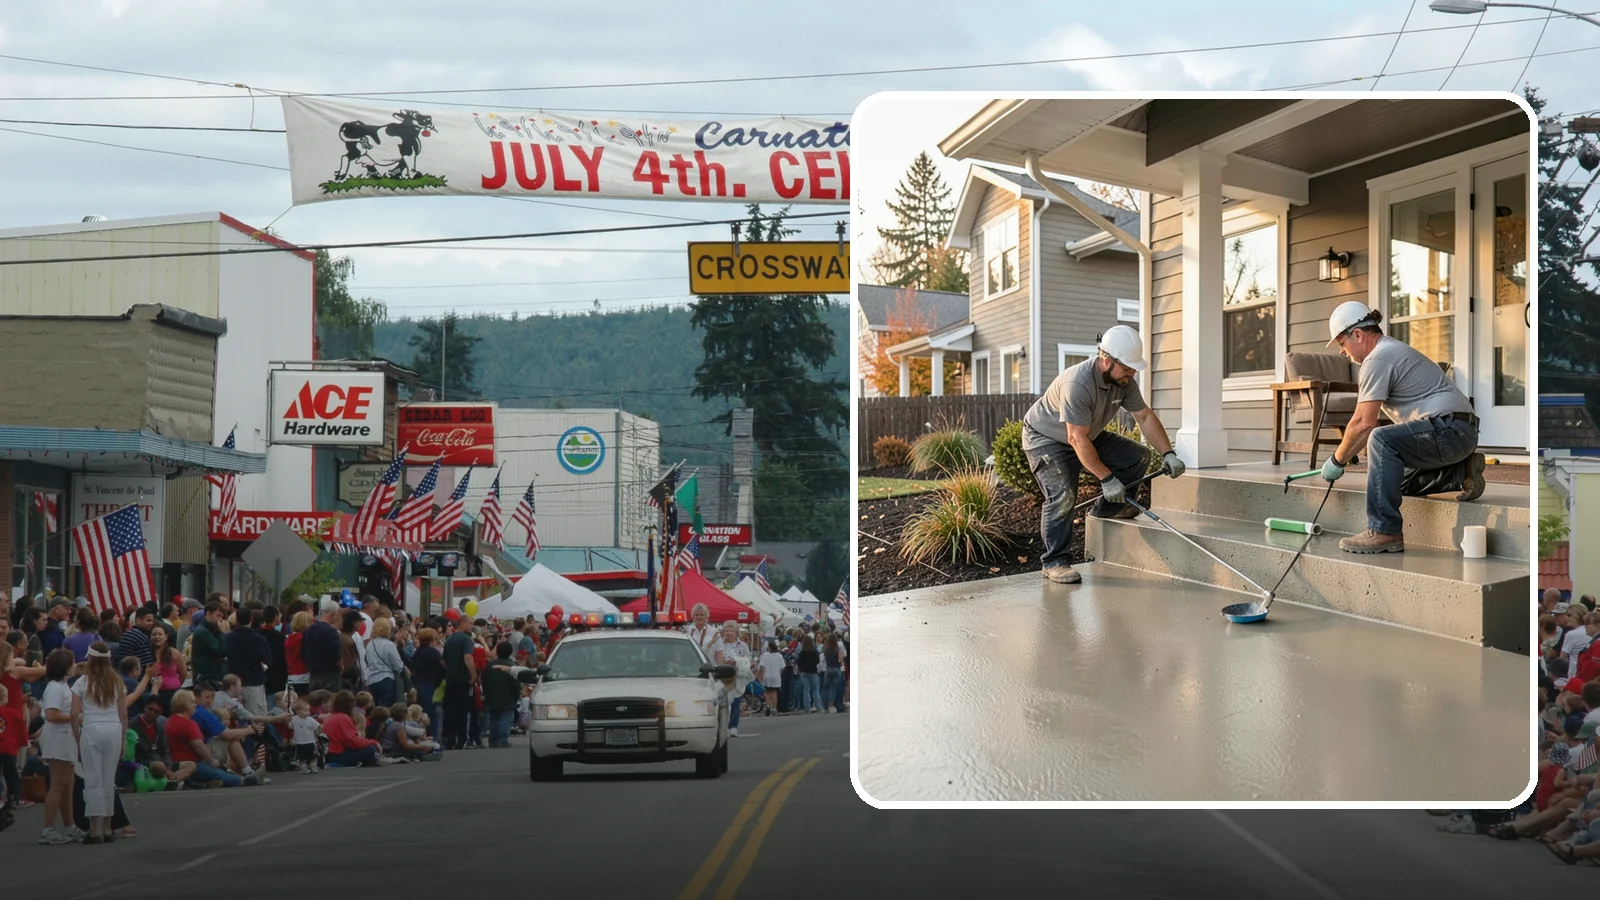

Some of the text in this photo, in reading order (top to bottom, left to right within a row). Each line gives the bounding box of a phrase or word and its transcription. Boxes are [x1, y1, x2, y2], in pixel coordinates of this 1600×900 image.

[481, 141, 604, 192] JULY
[632, 150, 746, 197] 4th.
[697, 254, 850, 279] CROSSWA
[283, 380, 373, 420] ACE
[406, 409, 452, 421] CEDAR
[284, 421, 371, 436] Hardware
[416, 428, 477, 447] Coca-Cola
[95, 485, 124, 495] Vincent
[126, 486, 135, 494] de
[138, 486, 155, 495] Paul
[688, 526, 741, 535] CRNATION
[699, 535, 730, 543] GLASS
